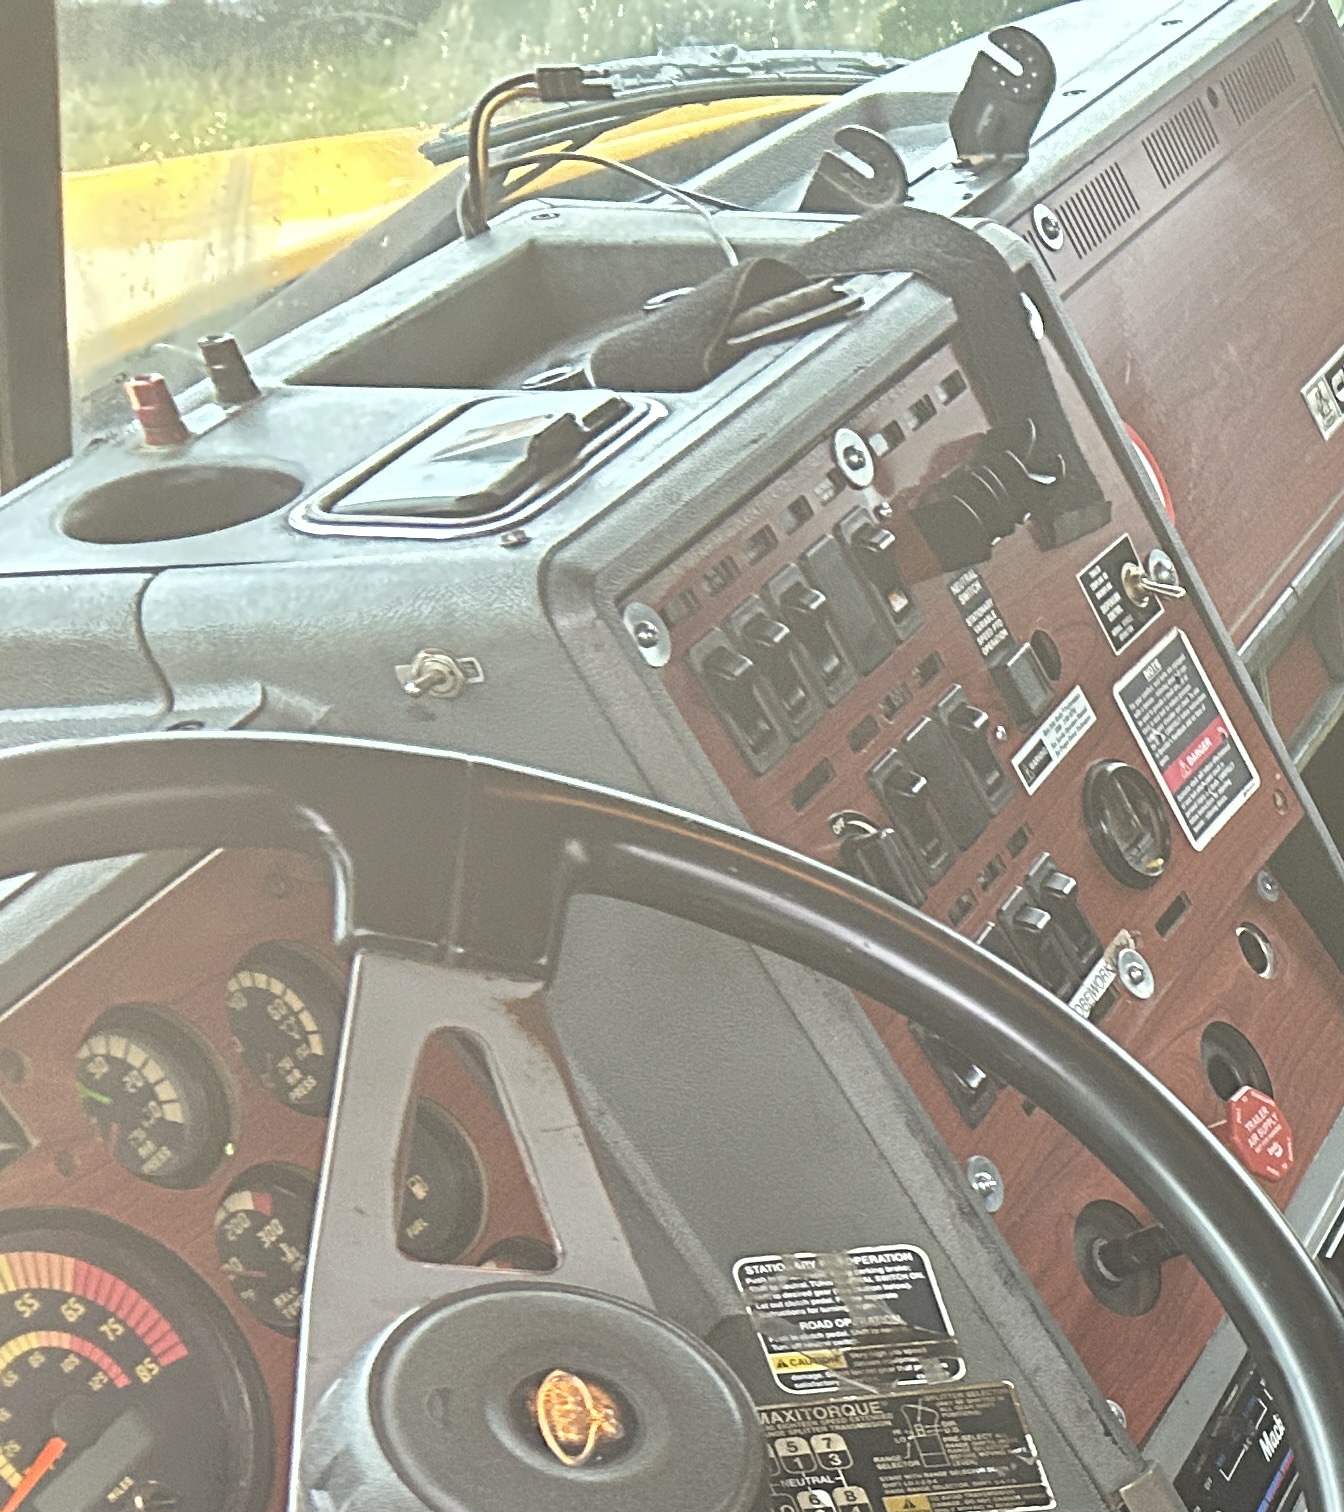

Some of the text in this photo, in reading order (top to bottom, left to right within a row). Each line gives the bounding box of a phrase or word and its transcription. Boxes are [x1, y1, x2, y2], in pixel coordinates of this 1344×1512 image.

[950, 569, 978, 595] NEUTRAL
[958, 580, 982, 605] SWITCH
[966, 598, 994, 627] STATIONARY
[973, 609, 997, 634] VARIABLE
[976, 618, 1003, 646] SPEED PTO
[981, 628, 1008, 656] OPERATION
[1143, 658, 1162, 682] NOTE
[1186, 737, 1213, 767] DANGER
[832, 817, 845, 835] OFF
[1244, 1106, 1270, 1133] TRAILER
[1248, 1132, 1260, 1148] AIR
[1257, 1112, 1279, 1139] SUPPLY
[256, 1218, 284, 1248] 300
[744, 1259, 817, 1274] STATIOARY
[14, 1292, 41, 1318] 55
[60, 1297, 86, 1322] 65
[99, 1317, 125, 1341] 75
[799, 1319, 833, 1330] ROAD
[135, 1357, 160, 1383] 85
[760, 1401, 883, 1425] MAXITORQUE
[786, 1441, 798, 1453] 5
[821, 1437, 832, 1449] 7
[1259, 1414, 1285, 1462] Mack
[794, 1457, 804, 1470] 1
[829, 1453, 842, 1466] 3
[780, 1475, 836, 1489] NEUTRAL
[809, 1493, 821, 1505] 6
[844, 1491, 857, 1502] 8
